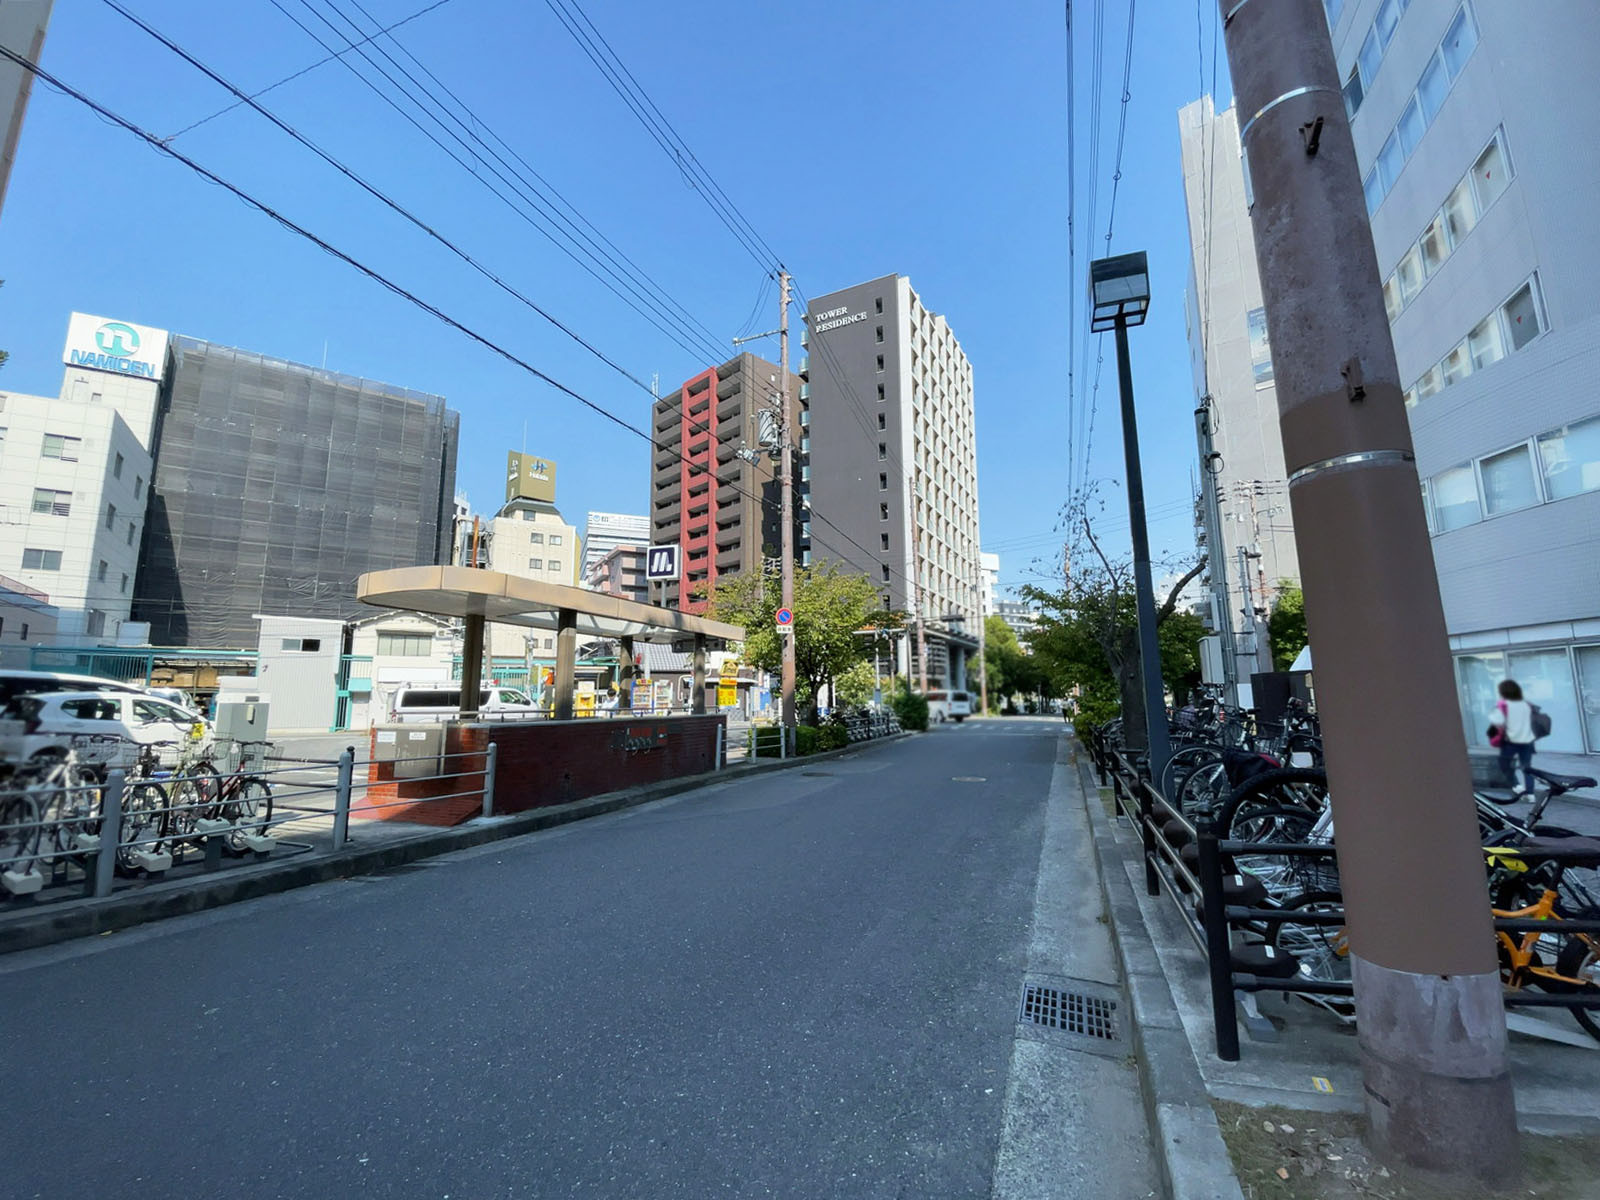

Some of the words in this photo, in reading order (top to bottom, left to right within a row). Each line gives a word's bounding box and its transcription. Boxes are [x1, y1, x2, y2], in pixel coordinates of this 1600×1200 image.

[815, 306, 848, 322] TOWER
[815, 311, 868, 334] RESIDENCE
[70, 349, 156, 378] NAMIDEN
